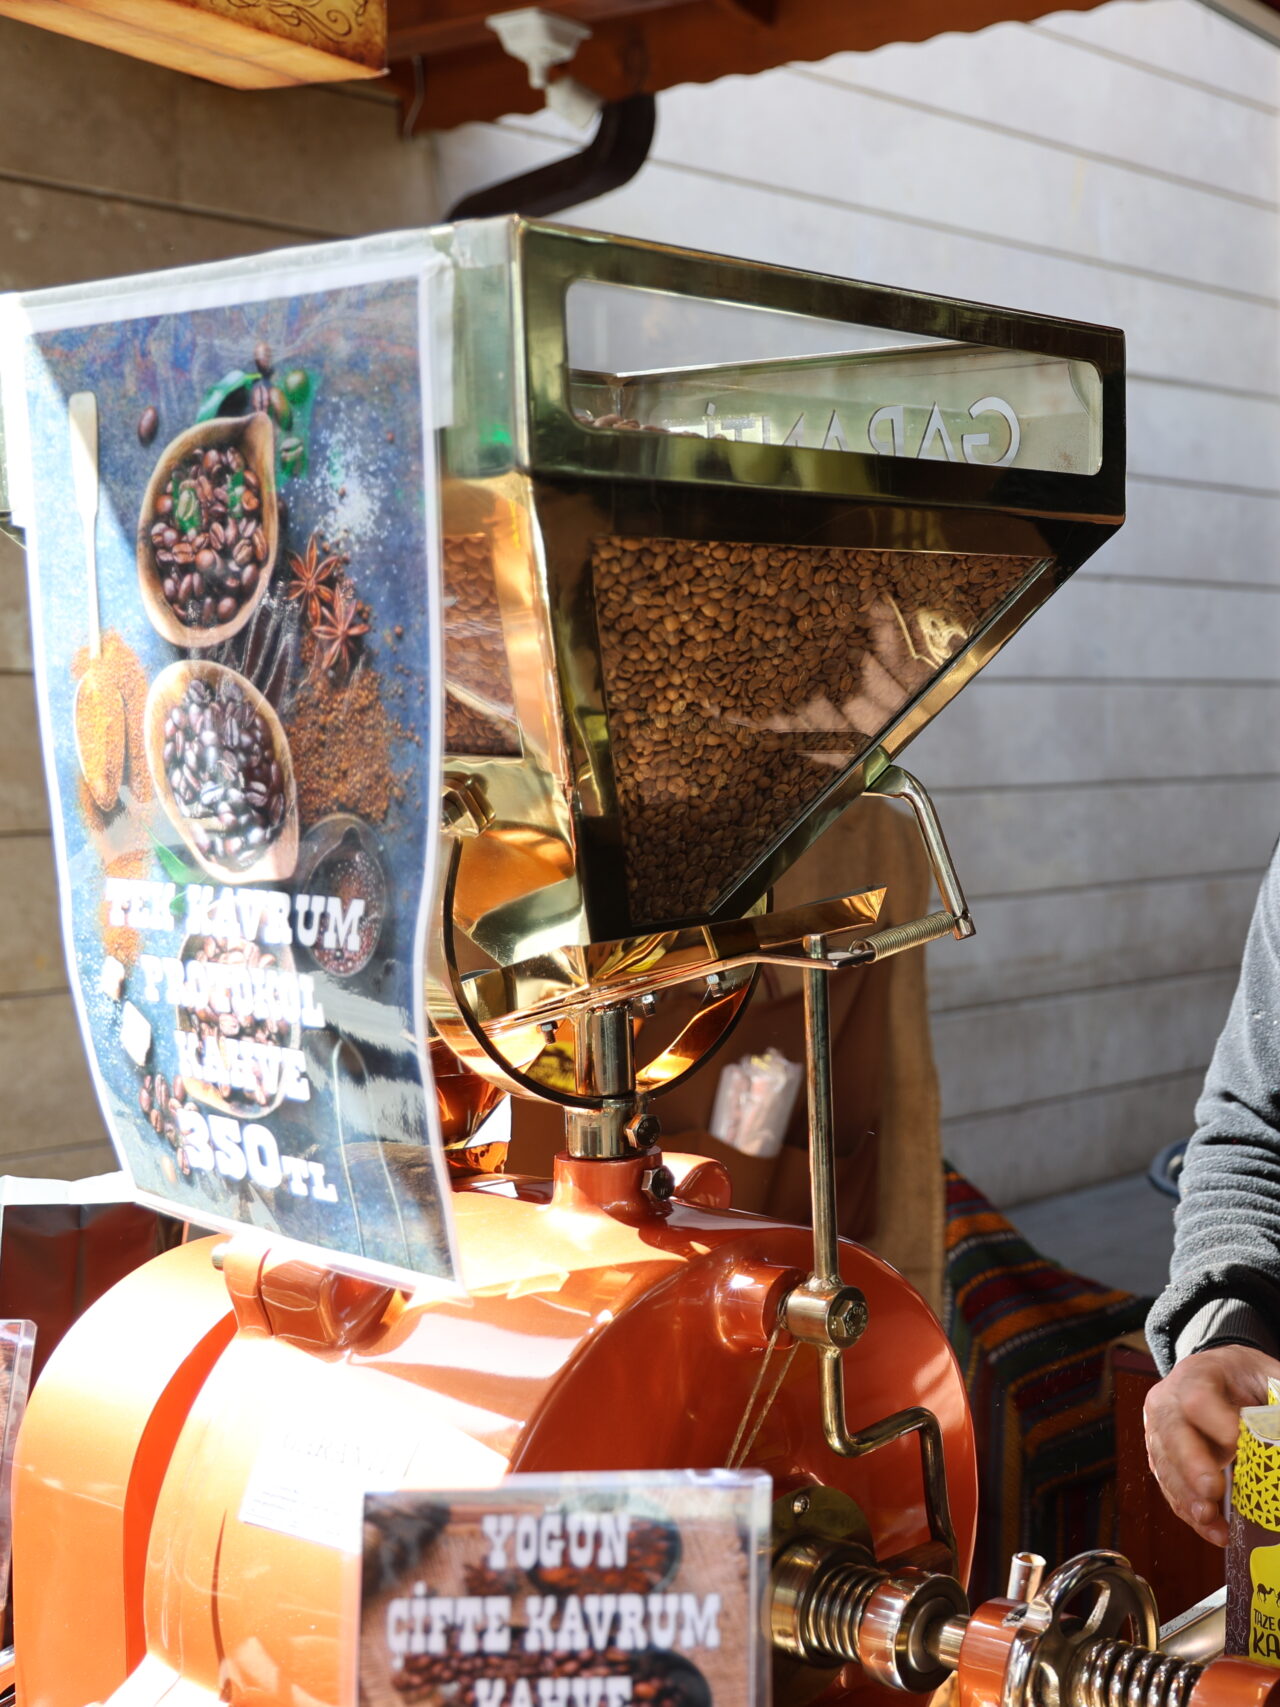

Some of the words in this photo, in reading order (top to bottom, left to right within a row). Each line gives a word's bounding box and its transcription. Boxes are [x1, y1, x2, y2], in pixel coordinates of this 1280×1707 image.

[186, 883, 366, 952] KAVRUM
[174, 1029, 311, 1102] KAHVE
[386, 1580, 511, 1671] ÇİFTE
[524, 1592, 722, 1651] KAVRUM
[1254, 1608, 1276, 1631] TAZE
